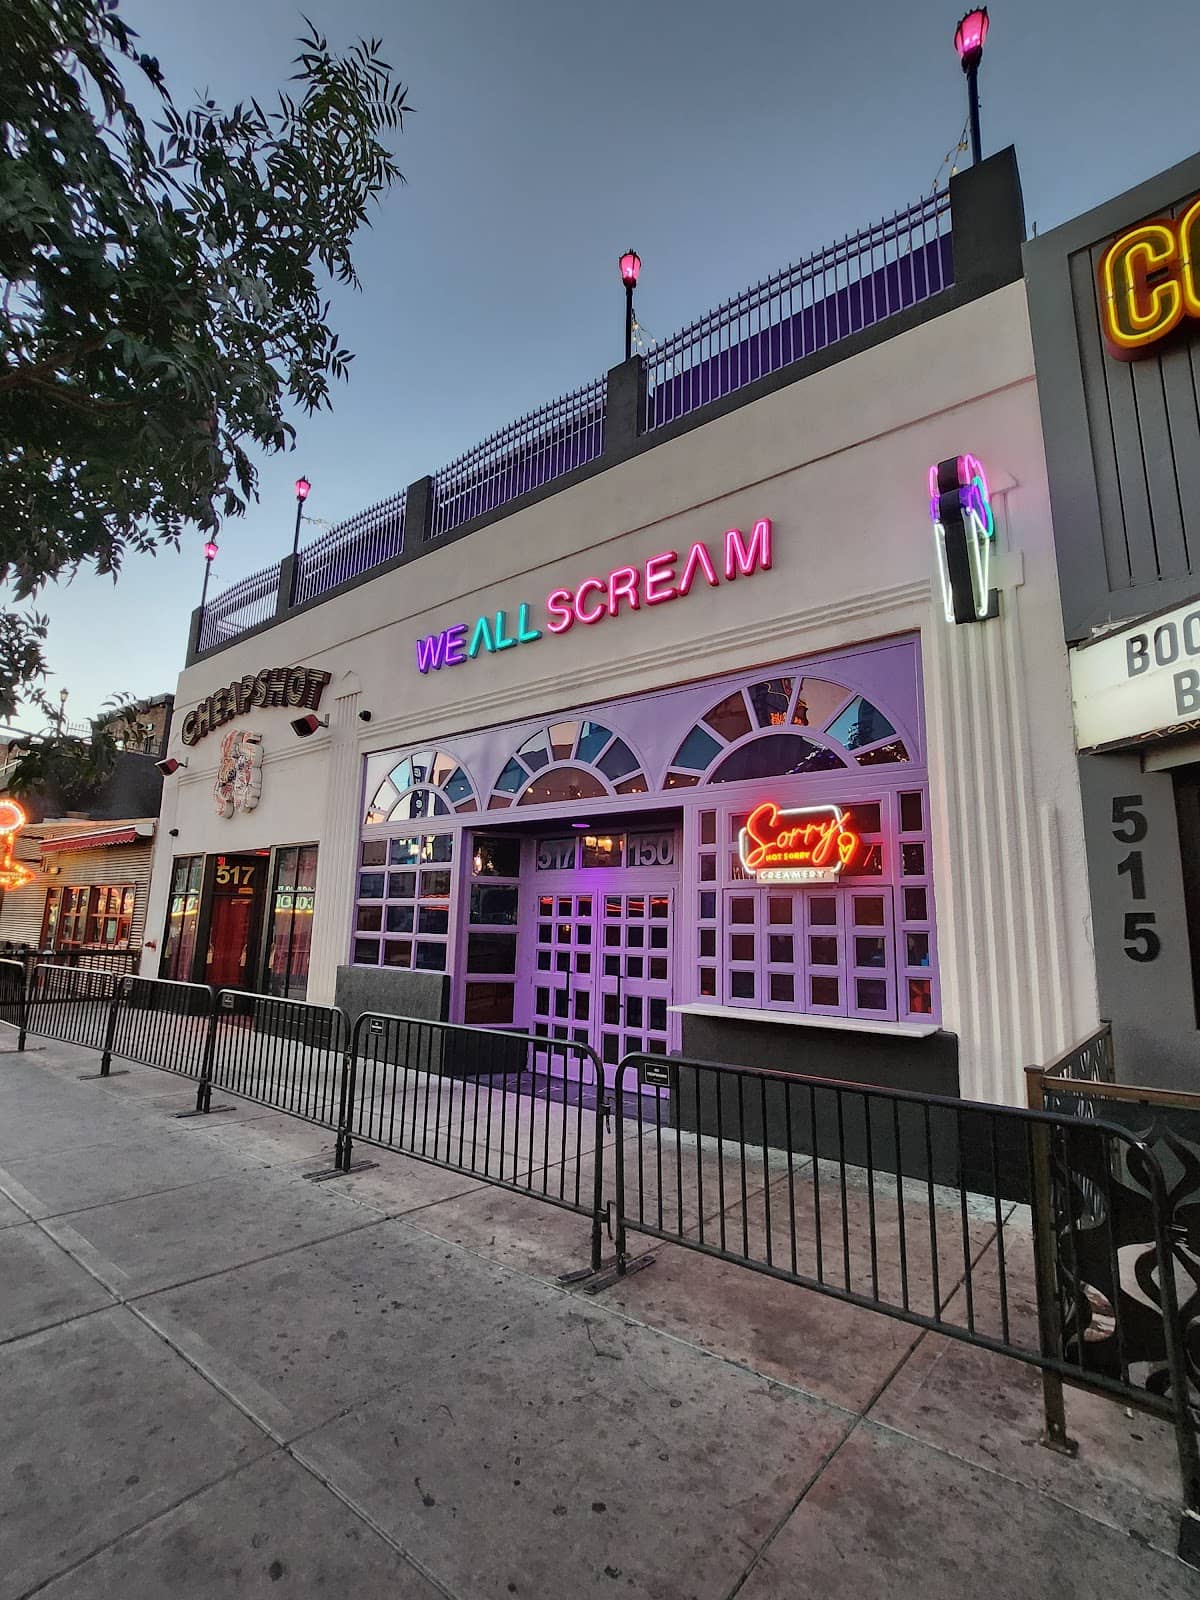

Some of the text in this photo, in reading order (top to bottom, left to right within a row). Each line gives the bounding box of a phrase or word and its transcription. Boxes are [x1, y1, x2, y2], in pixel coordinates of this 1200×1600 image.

[416, 517, 772, 674] WE ALL SCREAM
[182, 665, 332, 746] CHEAPSHOT
[629, 836, 674, 866] 150
[746, 802, 850, 867] Sorry
[216, 865, 255, 885] 517
[760, 870, 825, 880] CREAMERY
